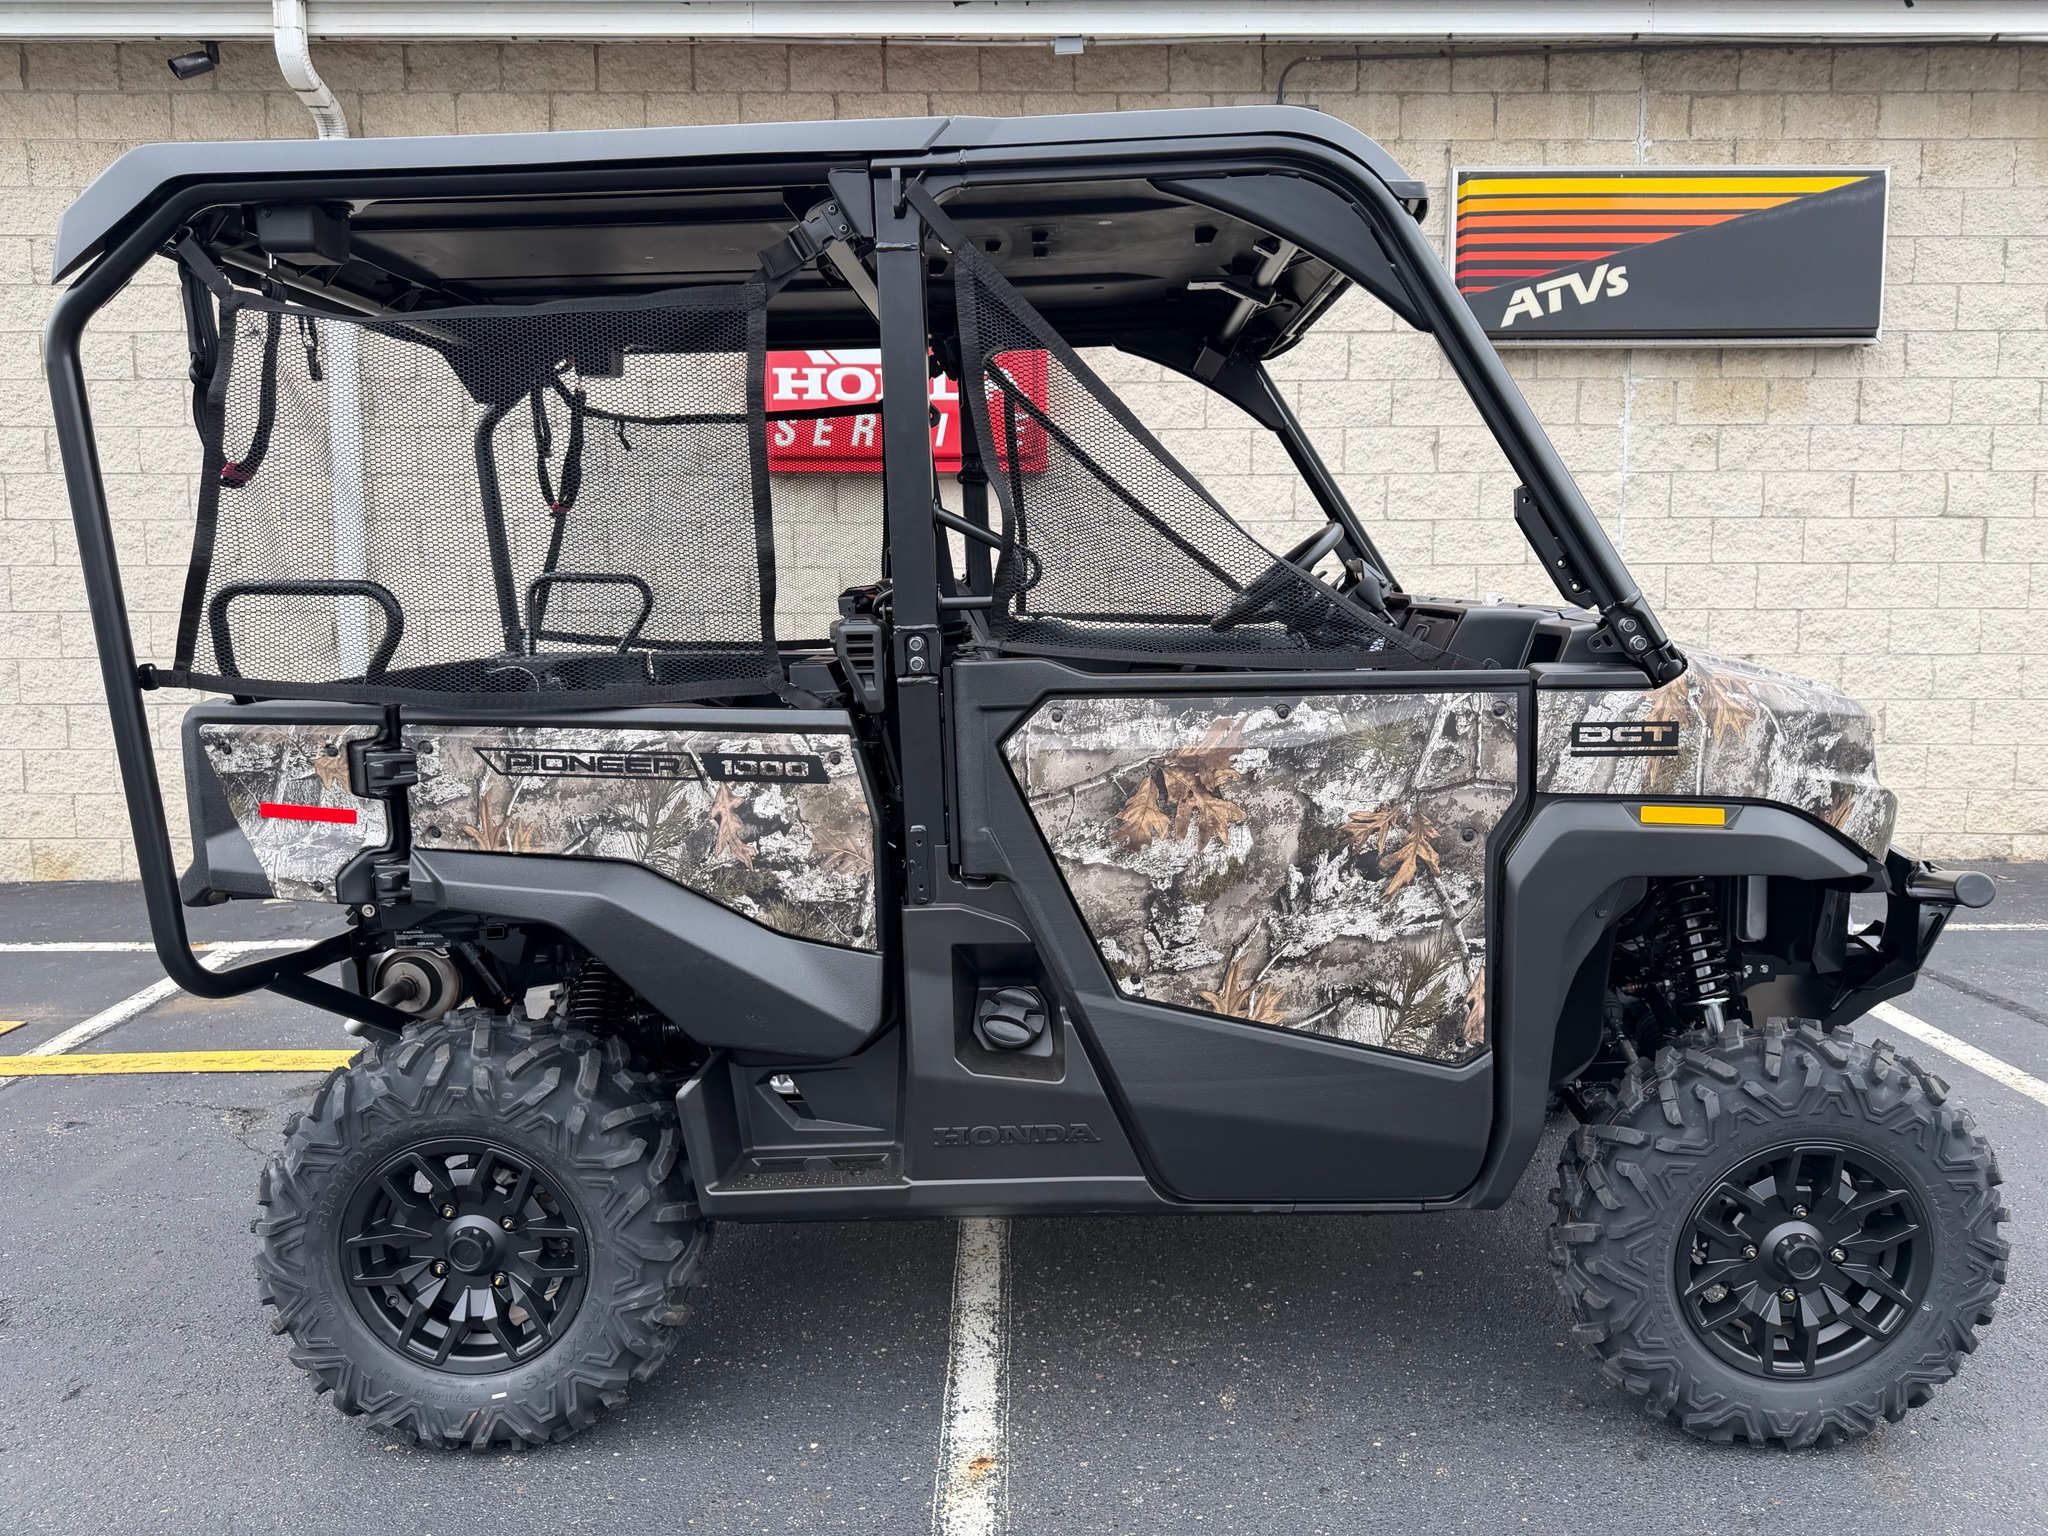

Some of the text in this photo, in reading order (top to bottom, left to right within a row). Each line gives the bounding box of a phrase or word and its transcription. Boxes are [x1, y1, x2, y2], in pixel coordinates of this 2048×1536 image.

[1499, 262, 1629, 328] ATVs
[1578, 725, 1673, 743] DCT
[505, 753, 810, 777] PIONEER 1000
[932, 1123, 1102, 1147] HONDA
